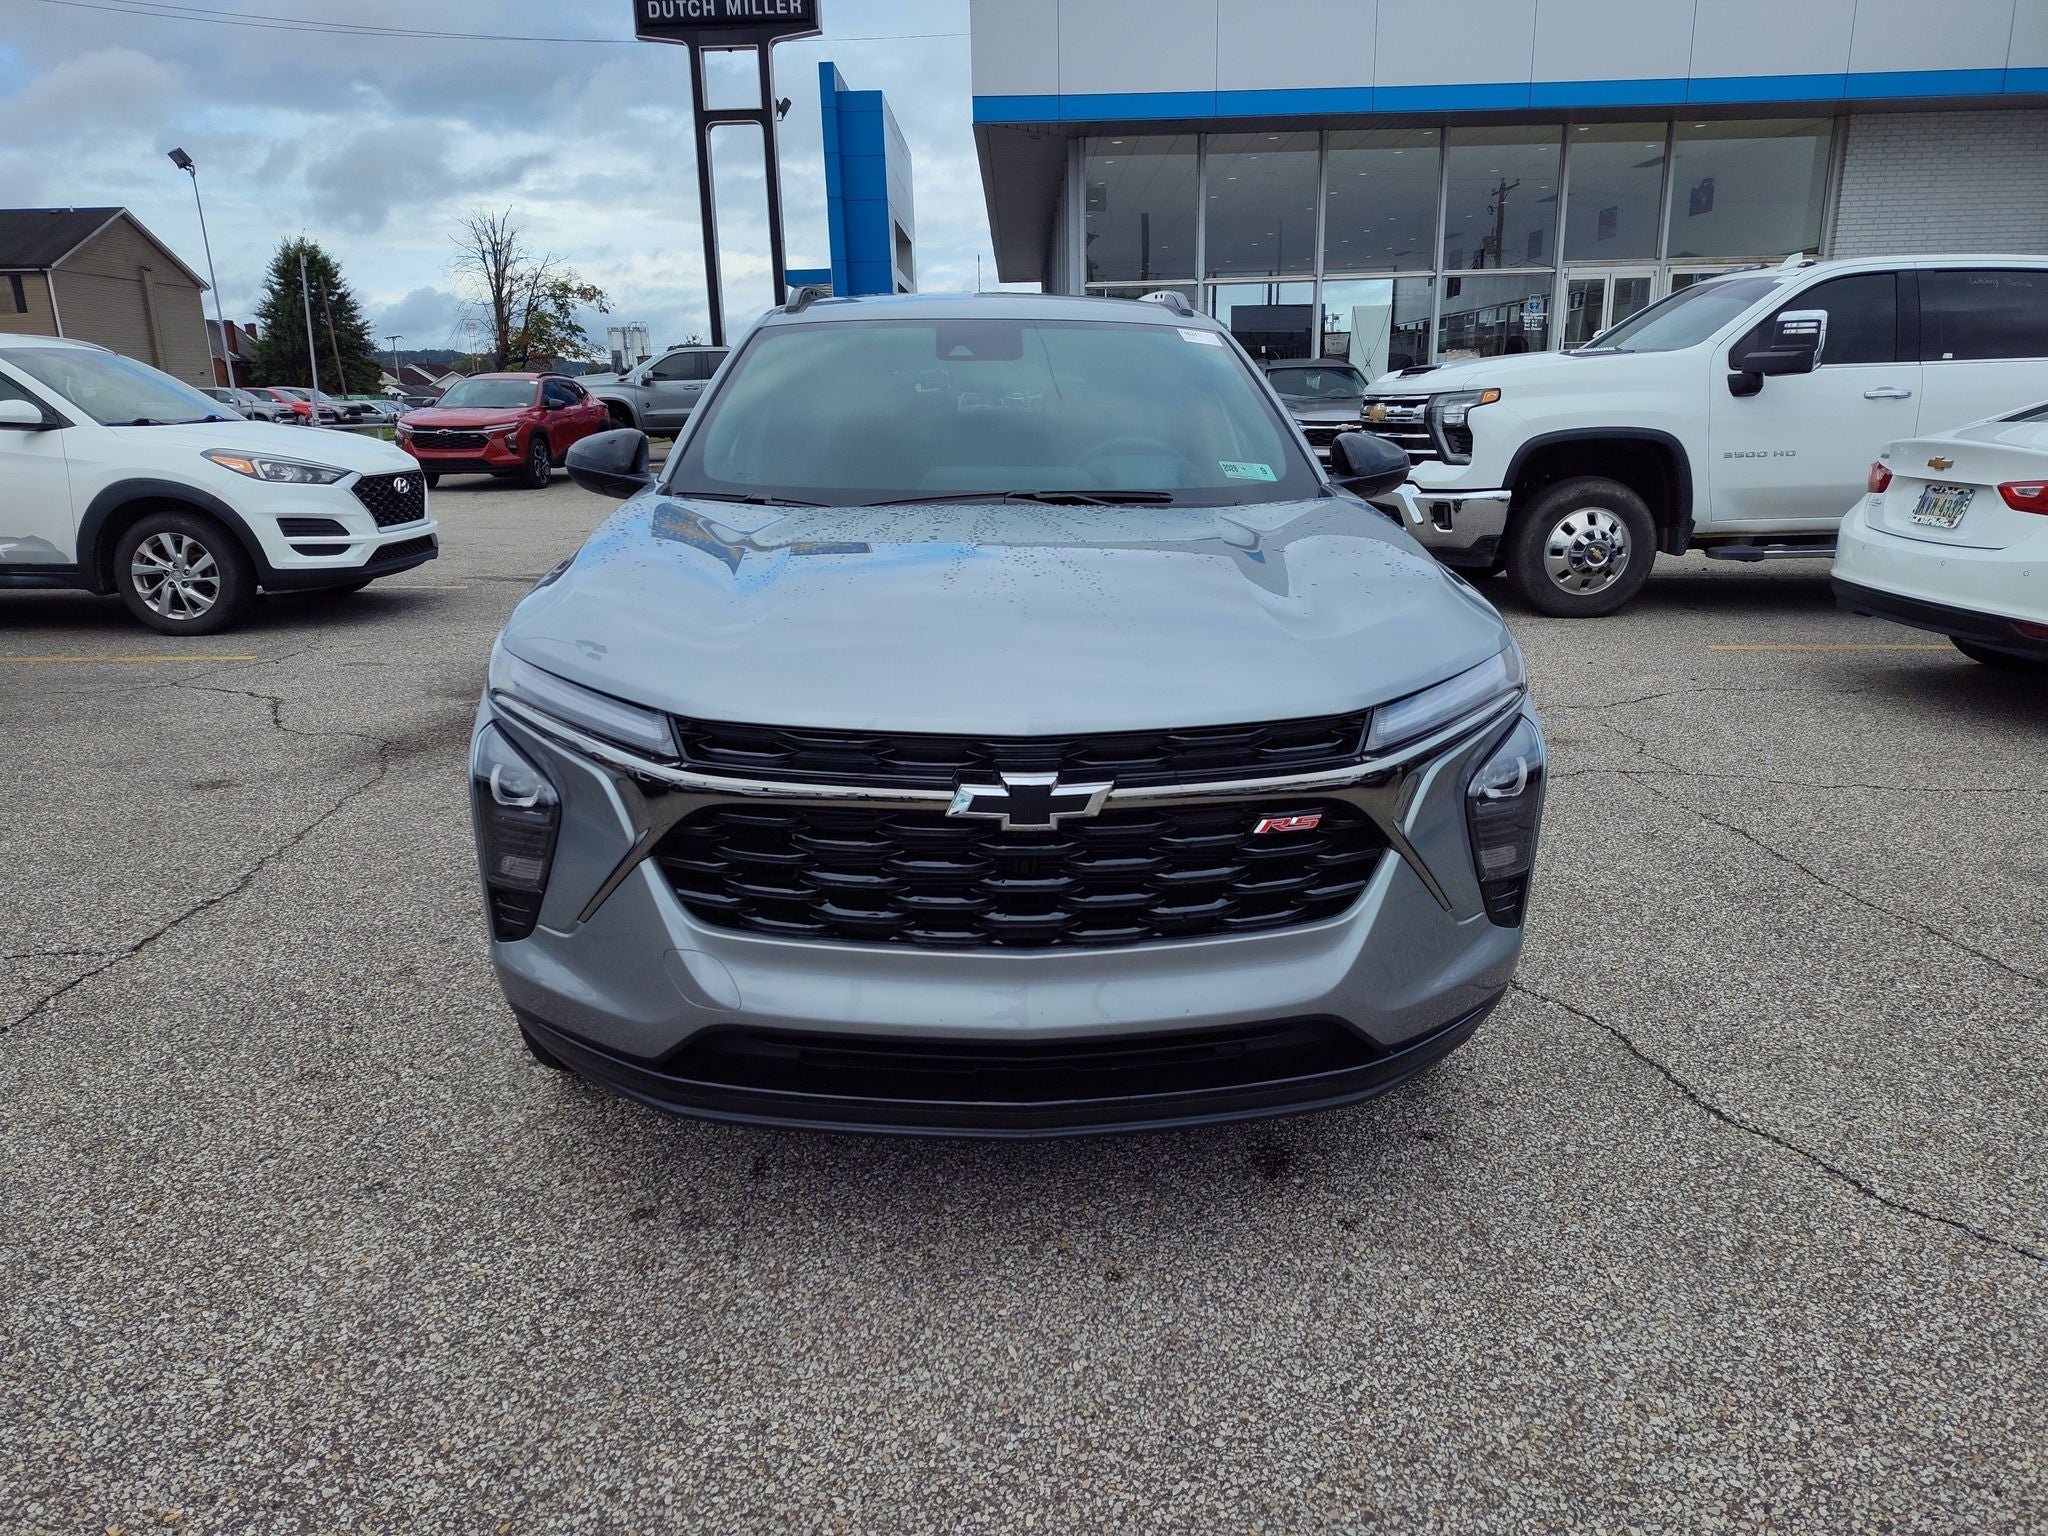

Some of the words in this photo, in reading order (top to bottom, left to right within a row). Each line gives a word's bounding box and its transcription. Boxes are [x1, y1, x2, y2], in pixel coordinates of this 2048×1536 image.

[648, 0, 715, 18] DUTCH
[727, 0, 802, 15] MILLER
[1253, 814, 1322, 833] RS
